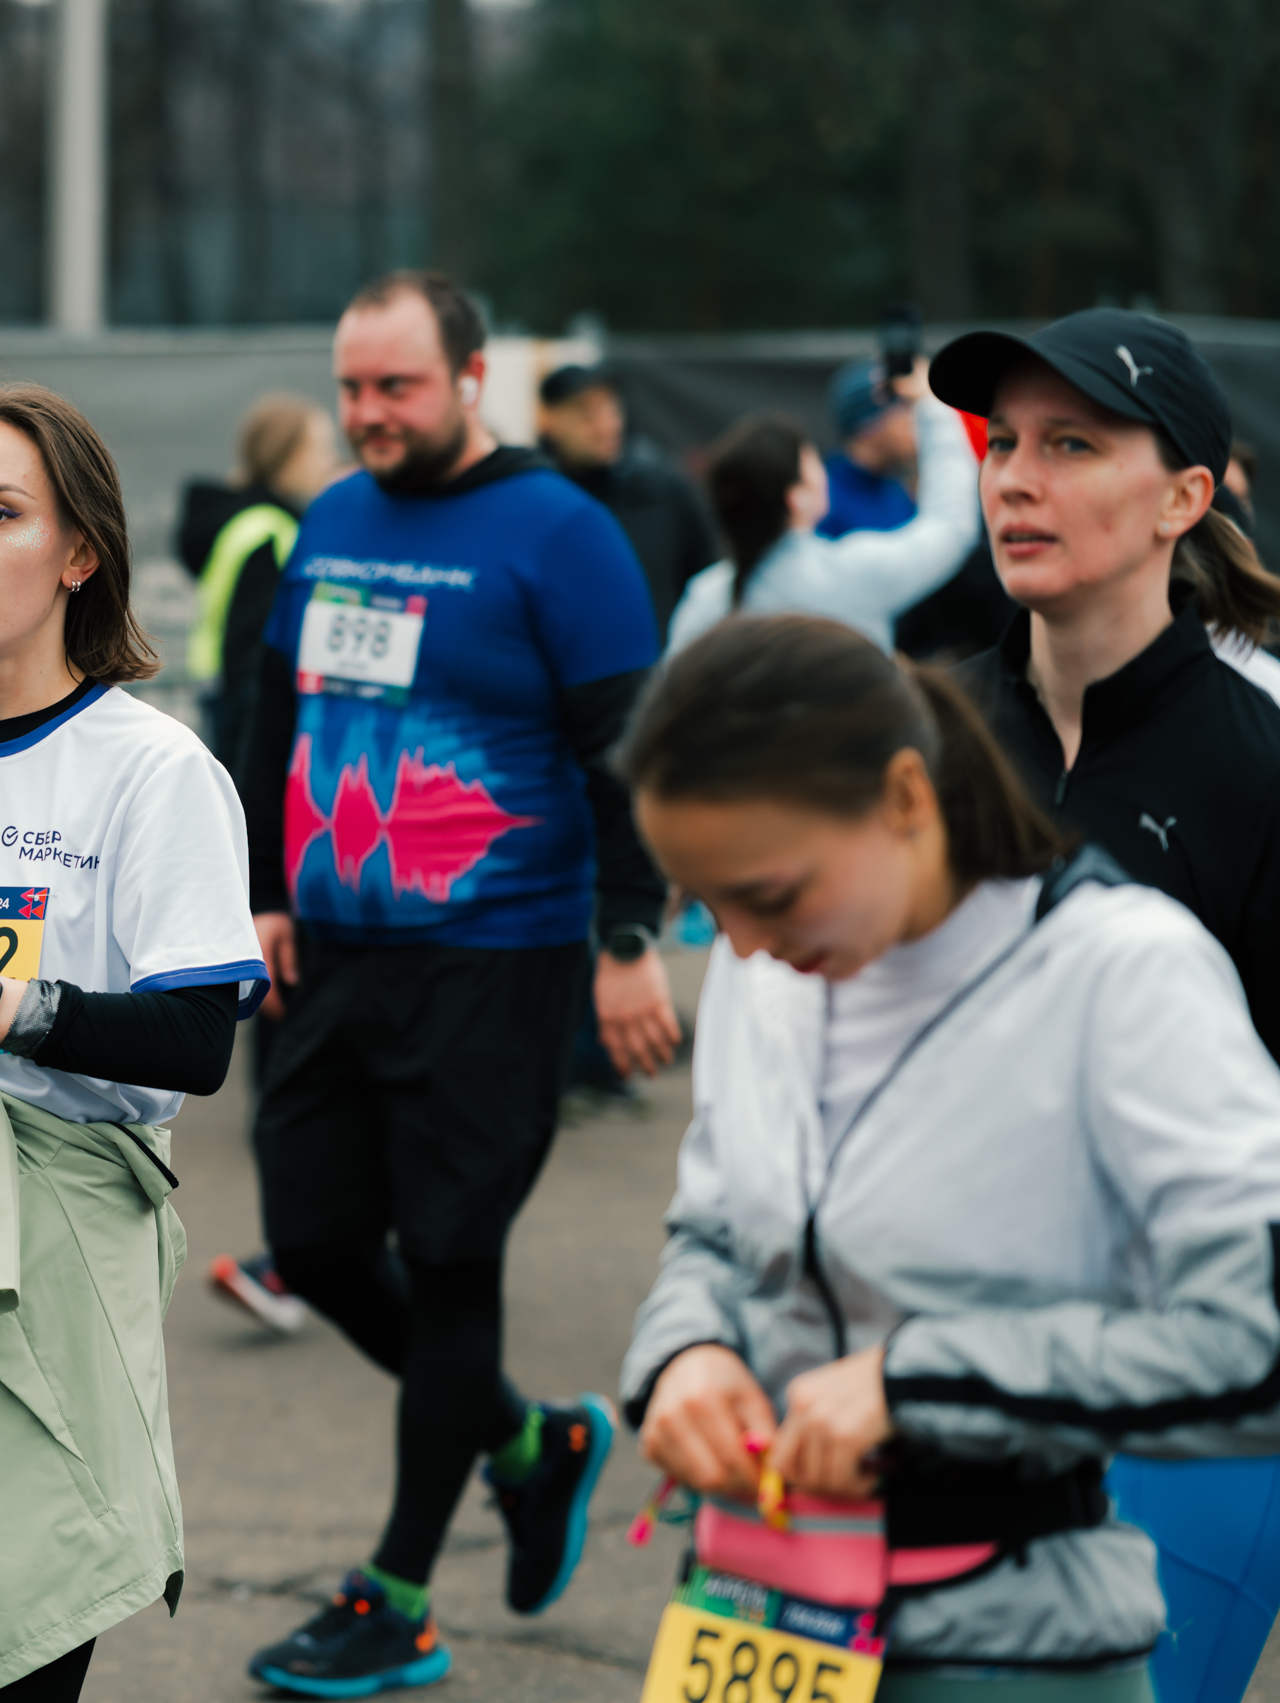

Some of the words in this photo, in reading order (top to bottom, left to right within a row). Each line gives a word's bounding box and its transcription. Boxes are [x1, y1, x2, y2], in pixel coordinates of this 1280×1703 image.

[328, 614, 390, 659] 898
[23, 830, 62, 846] СБЕР
[682, 1627, 842, 1703] 5895
